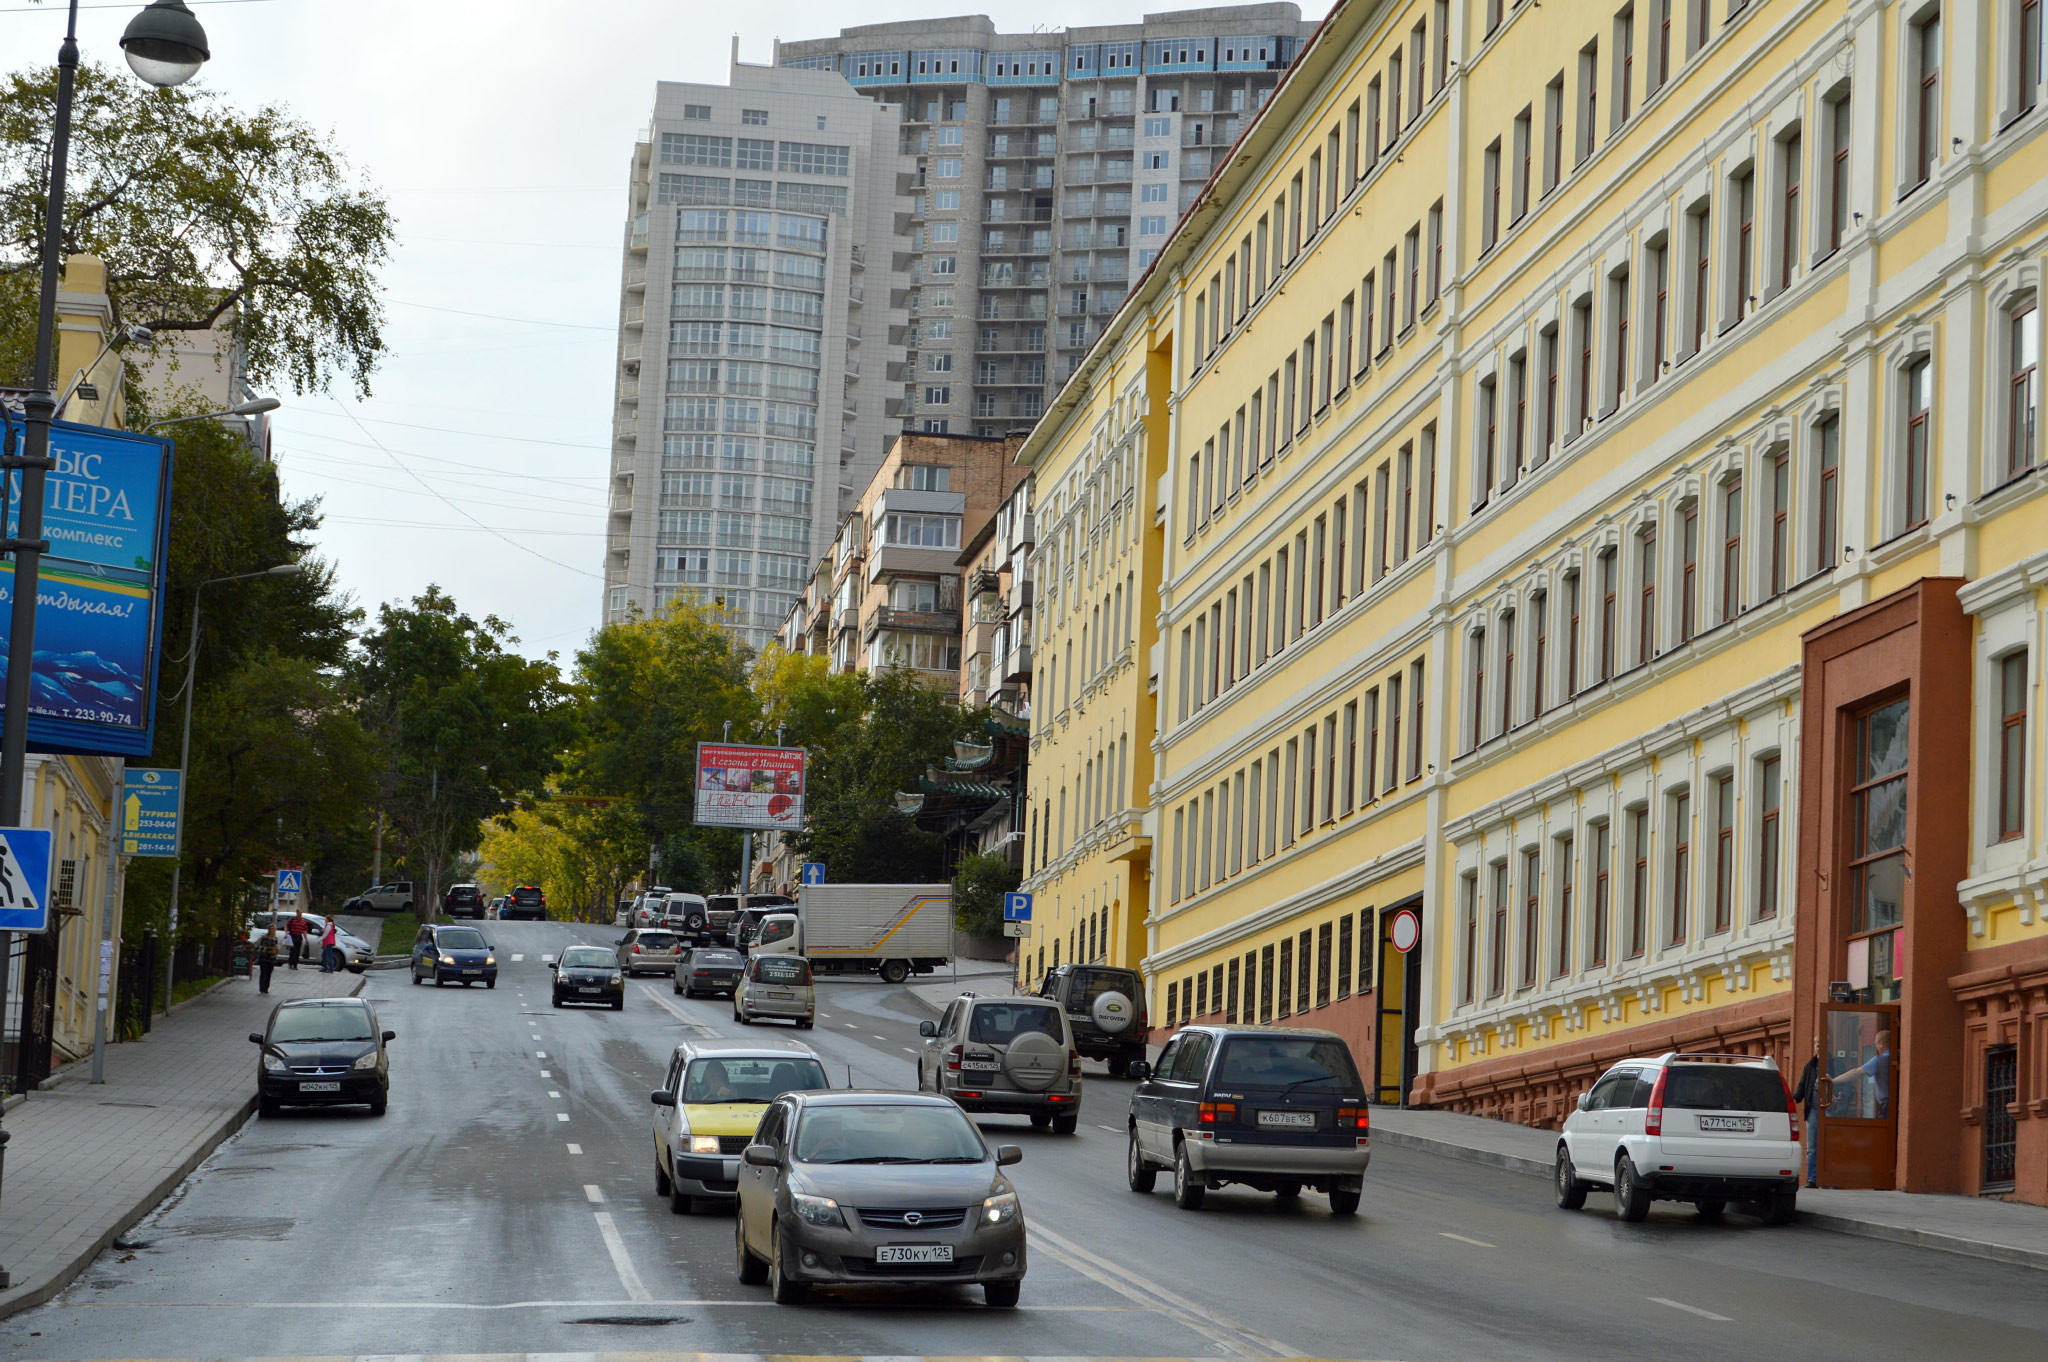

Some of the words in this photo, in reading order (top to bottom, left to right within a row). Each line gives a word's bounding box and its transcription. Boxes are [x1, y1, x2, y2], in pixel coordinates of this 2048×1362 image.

[43, 525, 124, 548] комплекс
[36, 591, 134, 618] тдыхая!
[75, 708, 132, 725] 233-90-74
[718, 759, 748, 767] сезона
[759, 759, 795, 769] Японии
[140, 810, 177, 818] ТУРИЗМ
[139, 820, 176, 828] 253-04-04
[122, 832, 175, 840] АВИАКАССЫ
[138, 843, 175, 851] 261-14-14
[1012, 896, 1027, 917] P
[1099, 1014, 1127, 1022] DISCOVERY
[1298, 1114, 1311, 1122] 125
[1704, 1117, 1737, 1128] А771СН
[1738, 1118, 1751, 1126] 125
[881, 1247, 928, 1261] Е730КУ
[931, 1246, 950, 1257] 125
